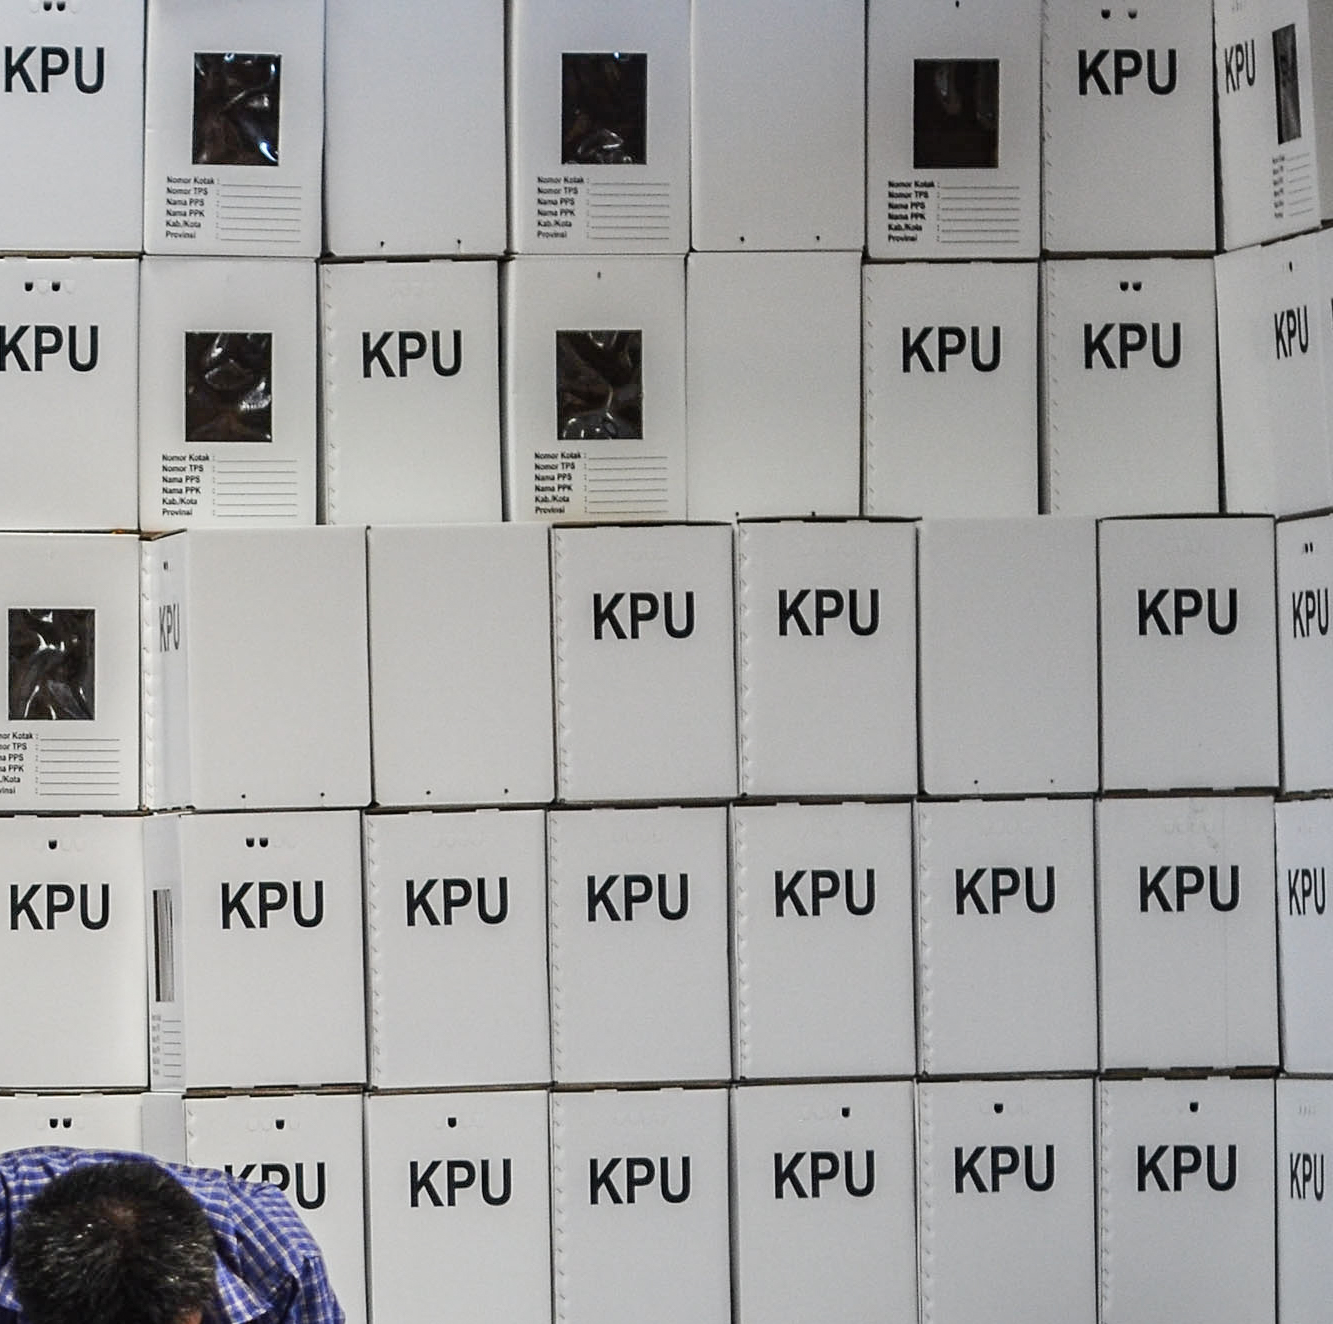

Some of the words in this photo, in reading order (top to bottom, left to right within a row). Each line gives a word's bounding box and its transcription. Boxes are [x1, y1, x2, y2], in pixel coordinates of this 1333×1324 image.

[4, 45, 105, 95] KPU
[1078, 48, 1177, 96] KPU
[1224, 39, 1256, 94] KPU
[362, 329, 462, 379] KPU
[902, 325, 1001, 374] KPU
[1083, 322, 1181, 370] KPU
[1273, 305, 1309, 360] KPU
[159, 603, 180, 652] KPU
[593, 591, 695, 641] KPU
[778, 588, 880, 637] KPU
[1137, 587, 1238, 636] KPU
[1291, 587, 1329, 639] KPU
[10, 883, 110, 931] KPU
[221, 880, 324, 930] KPU
[405, 876, 508, 927] KPU
[587, 873, 689, 923] KPU
[774, 868, 876, 918] KPU
[955, 865, 1056, 916] KPU
[1139, 864, 1240, 913] KPU
[1287, 866, 1326, 916] KPU
[409, 1158, 512, 1208] KPU
[589, 1156, 691, 1205] KPU
[773, 1149, 875, 1200] KPU
[954, 1144, 1055, 1194] KPU
[1137, 1144, 1237, 1192] KPU
[1289, 1152, 1325, 1202] KPU
